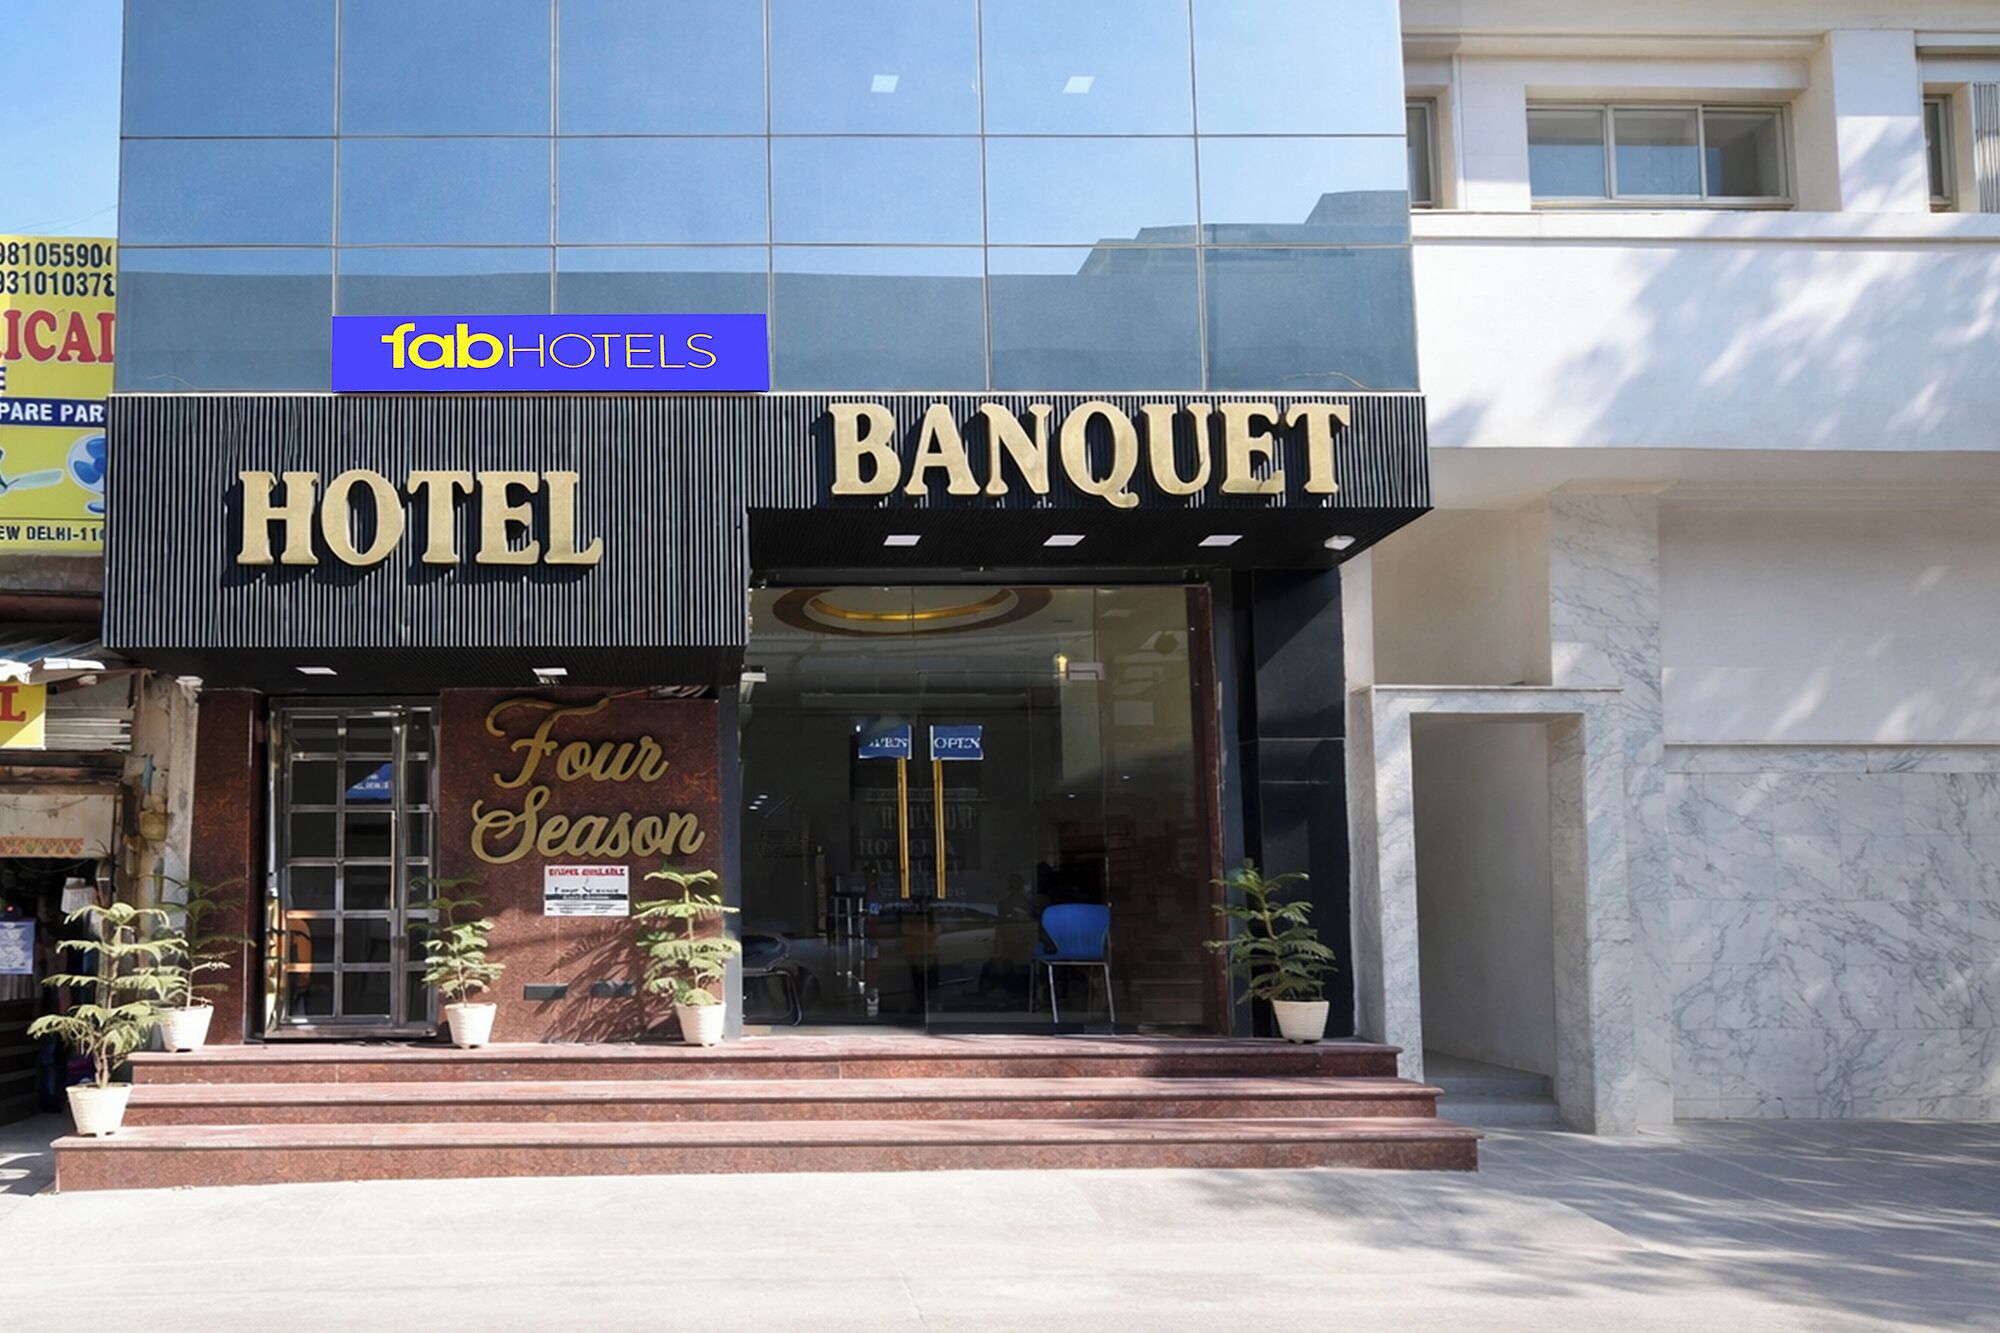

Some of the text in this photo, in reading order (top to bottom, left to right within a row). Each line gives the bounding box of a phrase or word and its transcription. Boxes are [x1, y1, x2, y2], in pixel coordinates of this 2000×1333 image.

[381, 323, 717, 371] fabHOTELS
[829, 402, 1350, 508] BANQUET
[237, 469, 603, 567] HOTEL
[486, 698, 669, 789] Four
[471, 785, 705, 864] Season
